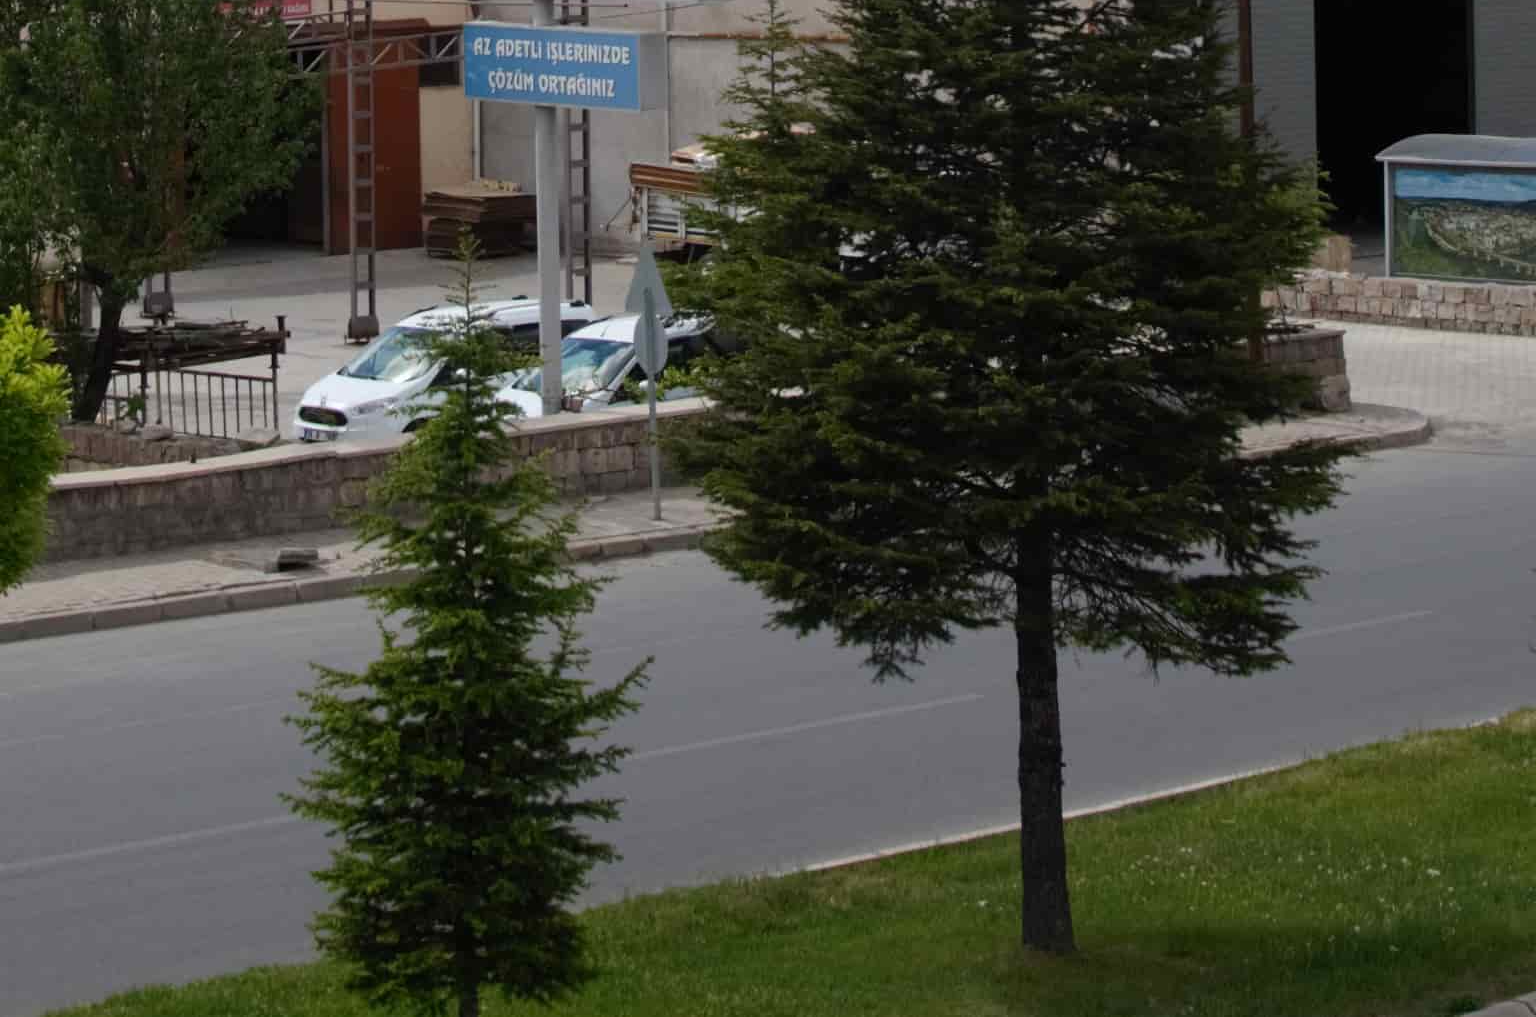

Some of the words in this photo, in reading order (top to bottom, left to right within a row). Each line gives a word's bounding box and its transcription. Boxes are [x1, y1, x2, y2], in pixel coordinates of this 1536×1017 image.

[473, 37, 491, 56] AZ
[488, 68, 534, 94] ÇÖZÜM
[538, 73, 615, 97] ORTAĞINIZ
